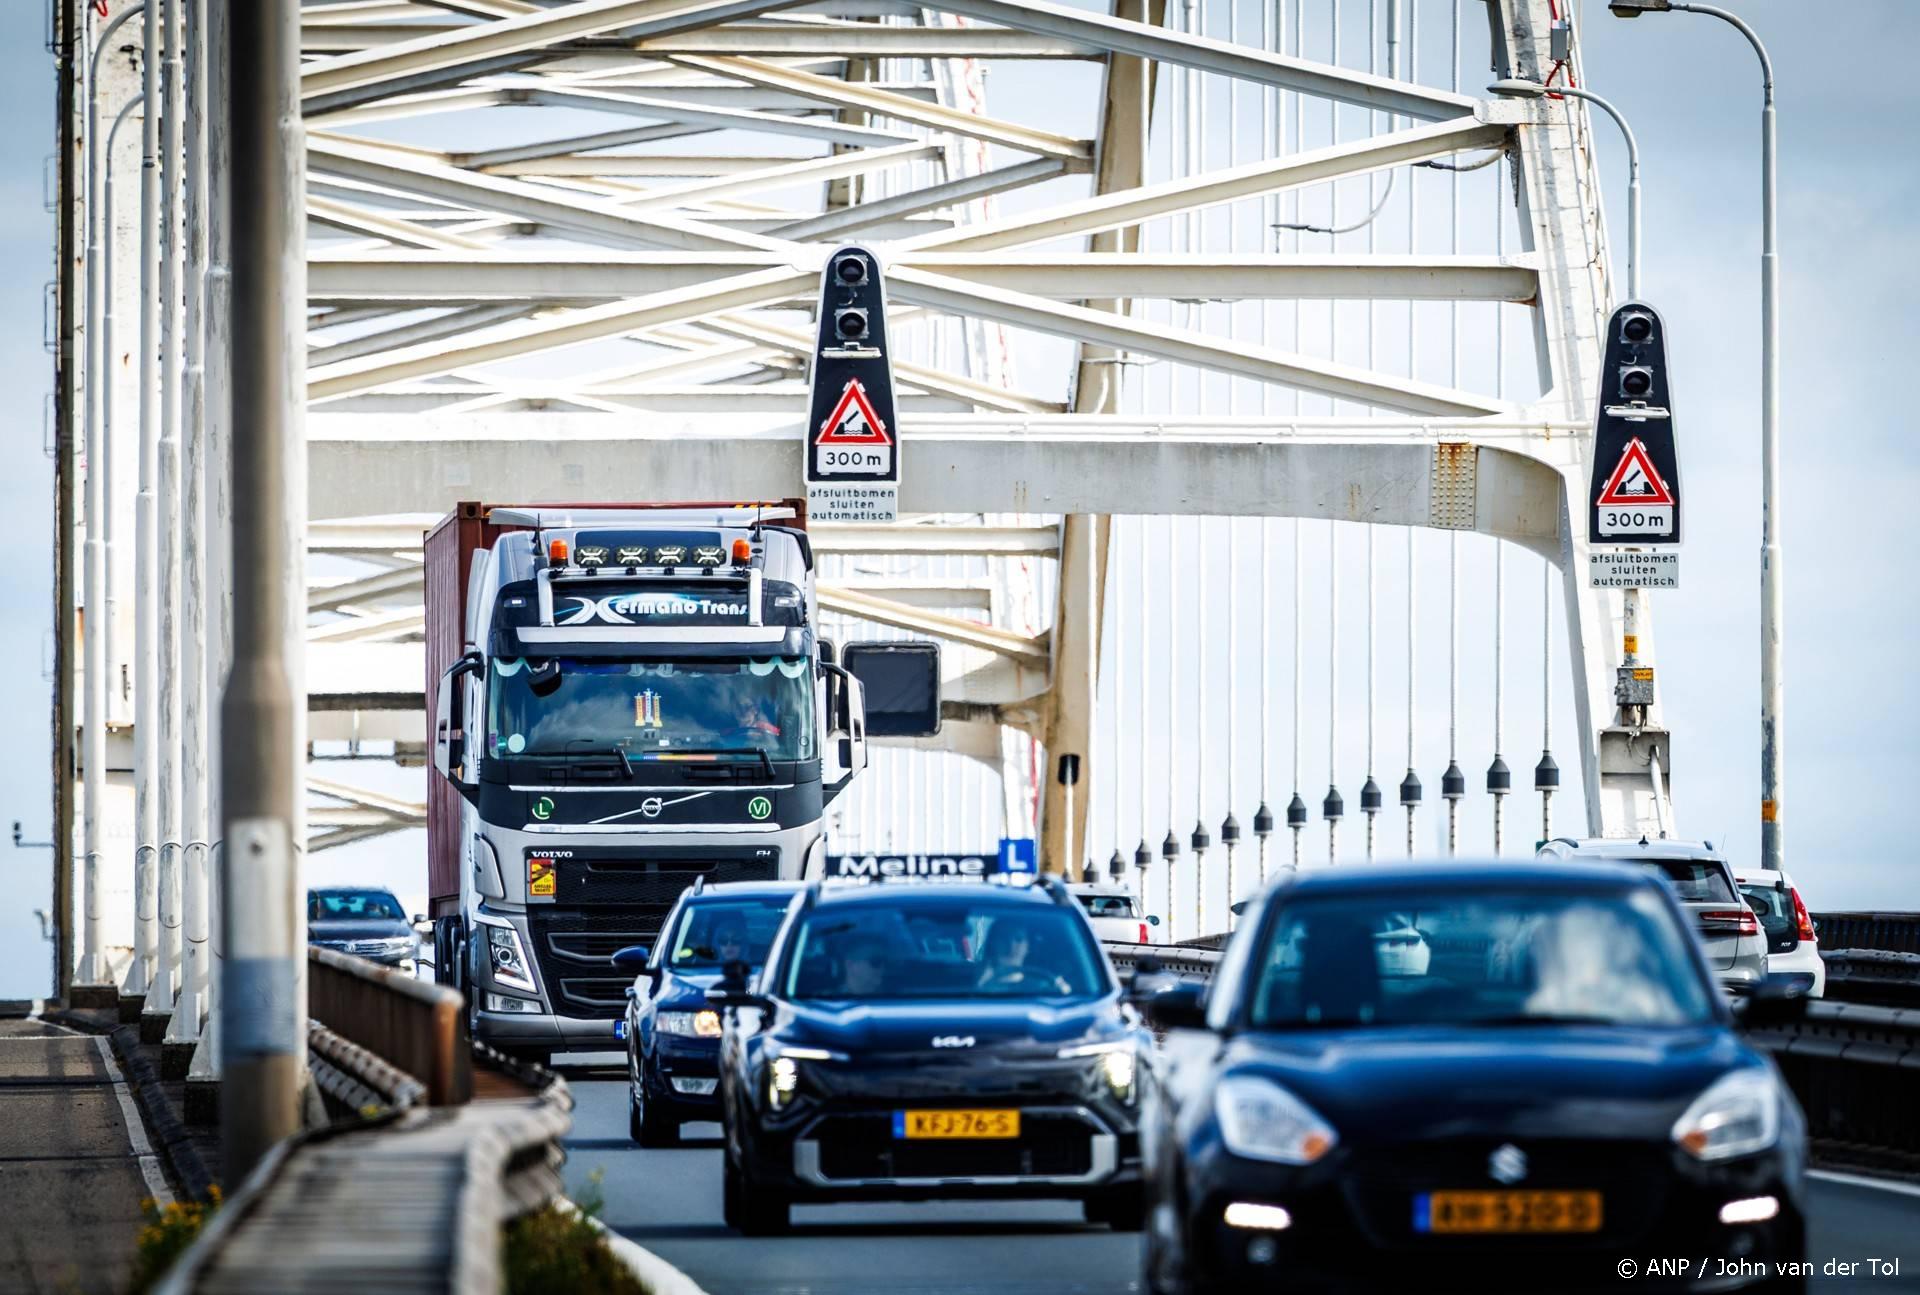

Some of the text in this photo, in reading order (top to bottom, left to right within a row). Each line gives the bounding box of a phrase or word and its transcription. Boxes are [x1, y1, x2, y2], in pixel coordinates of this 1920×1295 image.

[825, 452, 881, 465] 300 m
[810, 489, 895, 498] afsluitbomen
[829, 500, 874, 509] sluiten
[811, 510, 893, 520] automatisch
[1606, 513, 1664, 527] 300 m
[1591, 554, 1677, 563] afsluitbomen
[1611, 565, 1657, 574] sluiten
[1593, 576, 1675, 586] automatisch
[699, 600, 748, 615] Trans
[752, 802, 767, 815] VI
[1007, 842, 1028, 870] L
[838, 856, 986, 876] Meline
